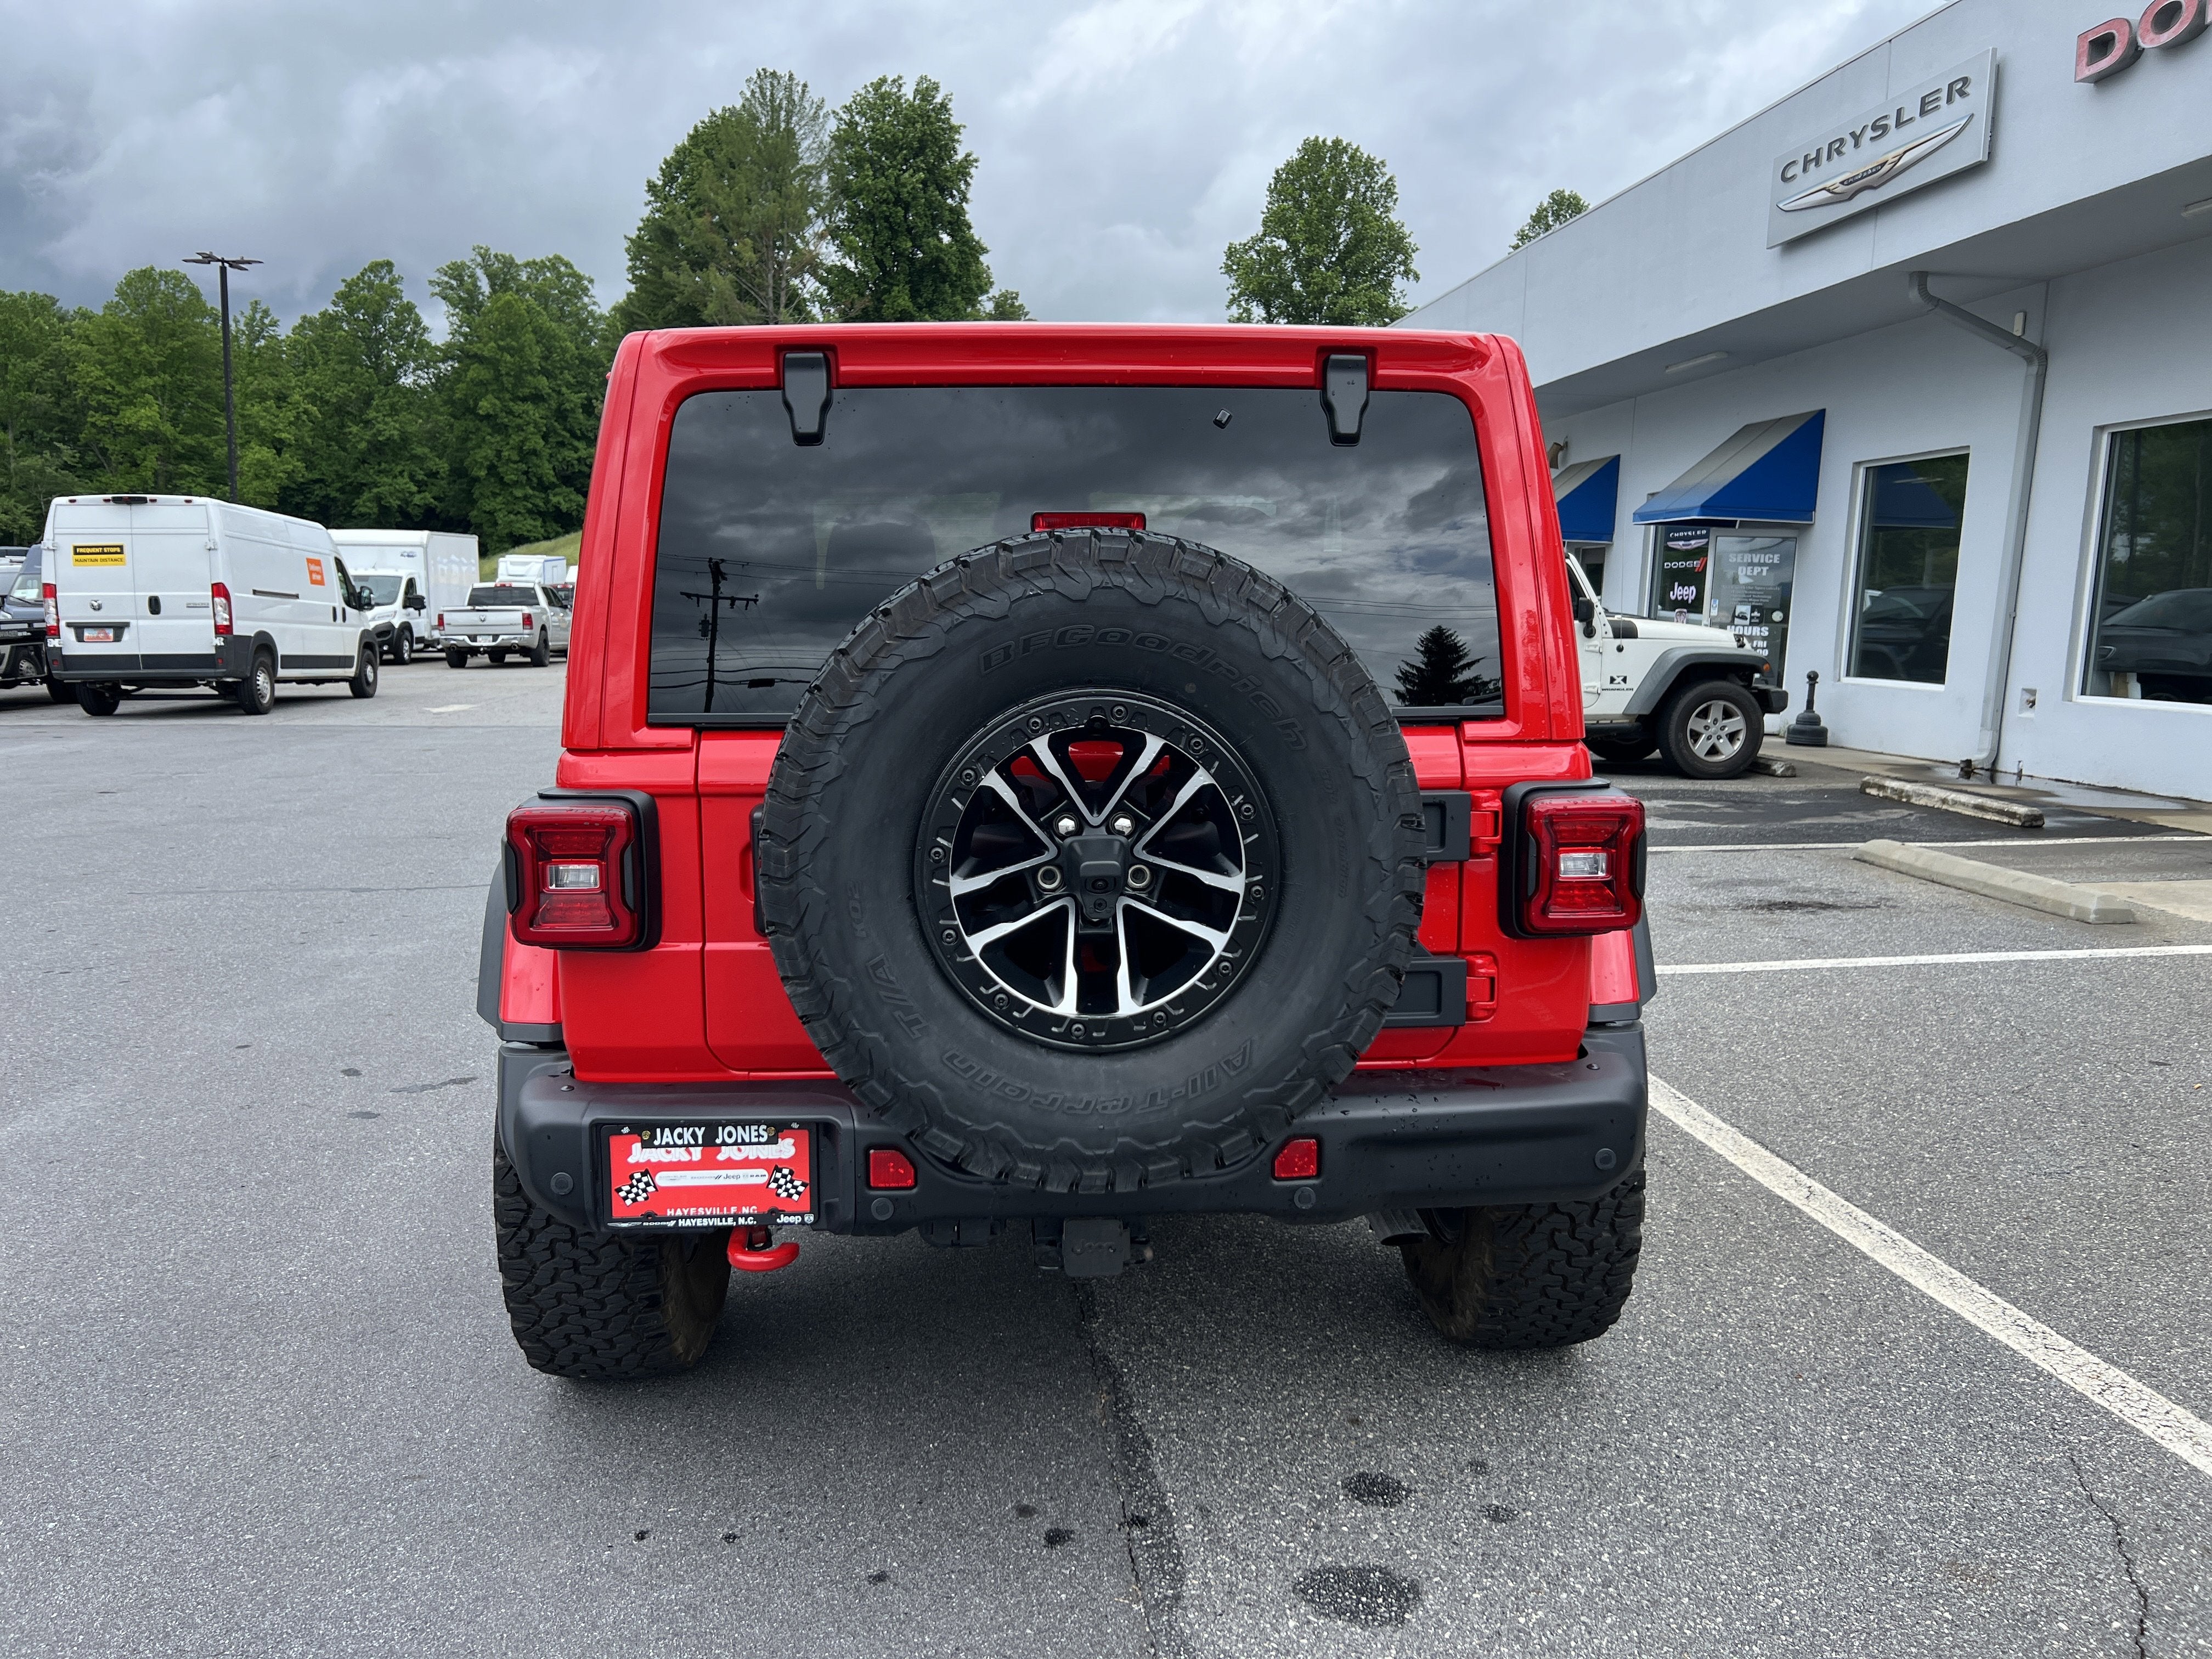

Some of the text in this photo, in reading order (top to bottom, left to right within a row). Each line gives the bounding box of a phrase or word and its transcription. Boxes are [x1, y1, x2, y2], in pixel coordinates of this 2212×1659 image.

[2074, 0, 2212, 83] DO
[1780, 76, 1972, 183] CHRYSLER
[1664, 560, 1701, 569] DODGE
[1729, 553, 1780, 563] SERVICE
[1738, 566, 1769, 576] DEPT
[1669, 581, 1696, 604] Jeep
[1726, 625, 1769, 636] HOURS
[978, 624, 1307, 752] BFGoodrich
[653, 1125, 768, 1146] JACKY JONES
[627, 1137, 796, 1163] JACKY JONES
[678, 1217, 736, 1227] HAYESVILLE,
[738, 1217, 757, 1226] N.C.
[776, 1214, 802, 1224] Jeep
